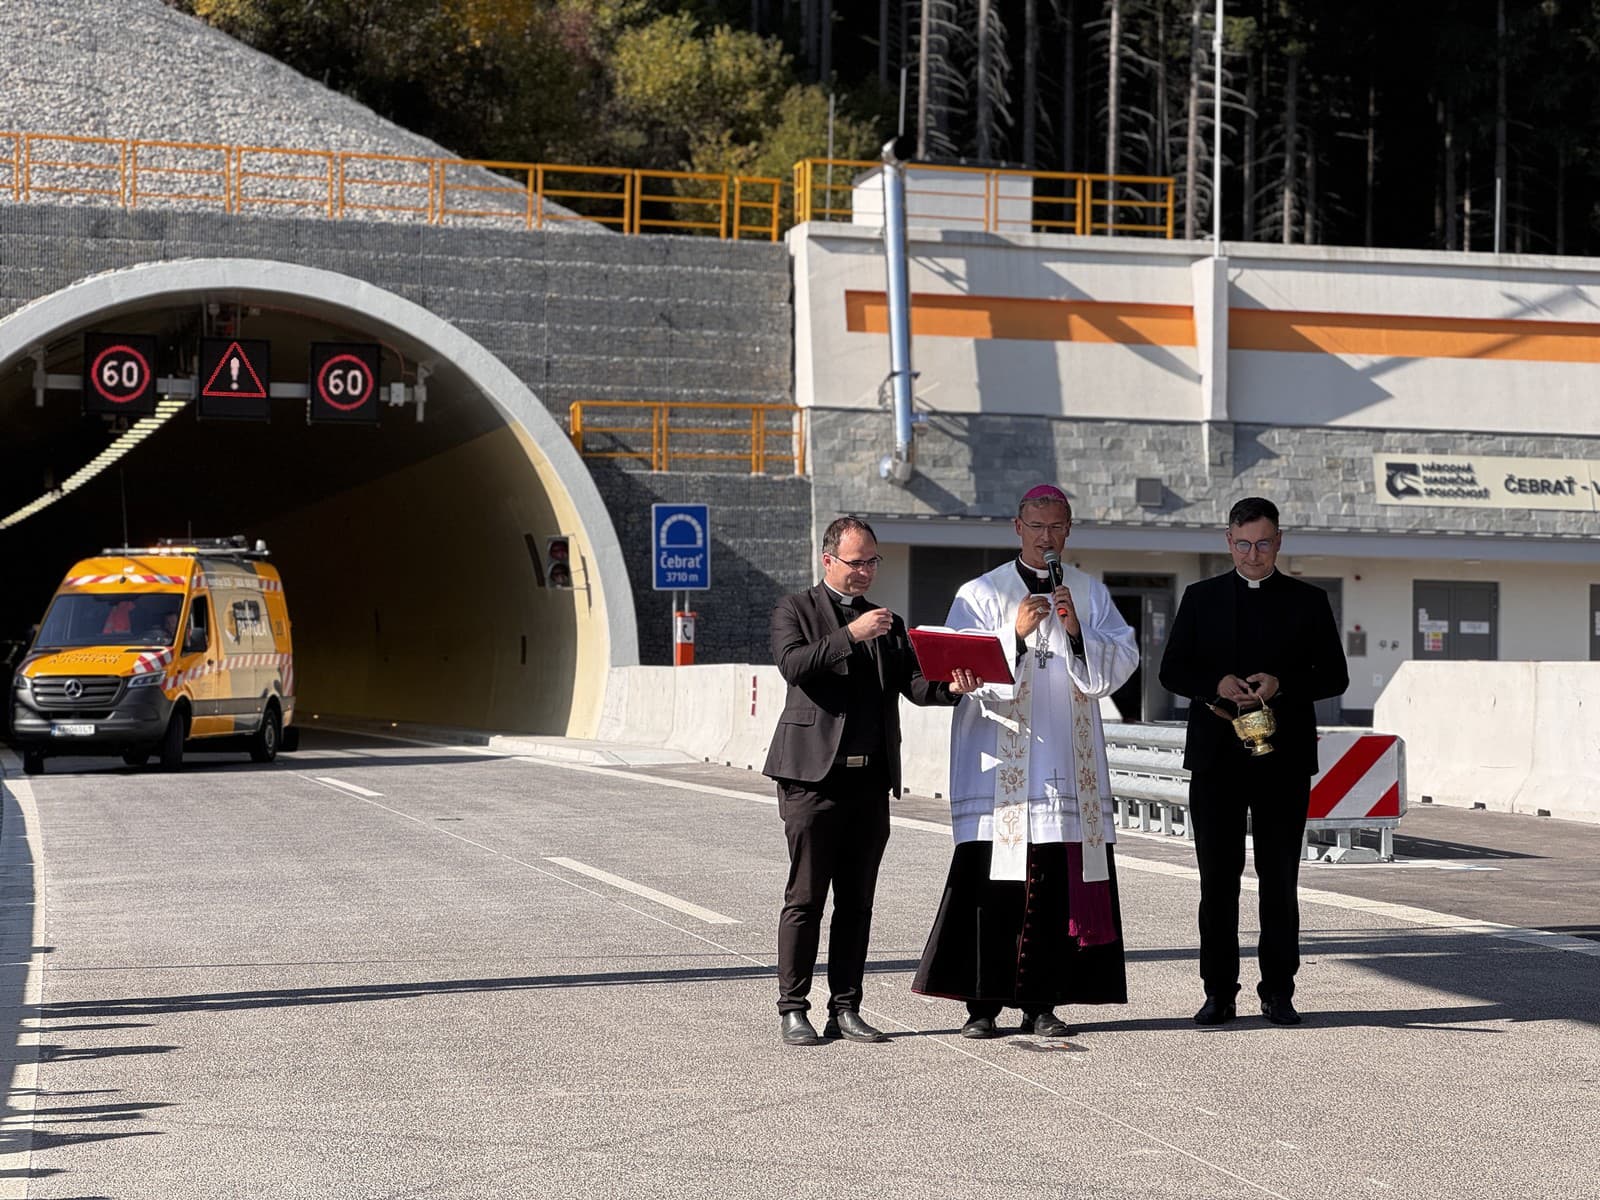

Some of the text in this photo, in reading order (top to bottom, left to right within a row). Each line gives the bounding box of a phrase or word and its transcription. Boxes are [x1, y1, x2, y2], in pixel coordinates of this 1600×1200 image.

[102, 360, 139, 388] 60
[328, 369, 364, 396] 60
[1503, 474, 1578, 496] ČEBRAŤ
[660, 551, 703, 569] Čebrať
[665, 572, 698, 582] 3710 m
